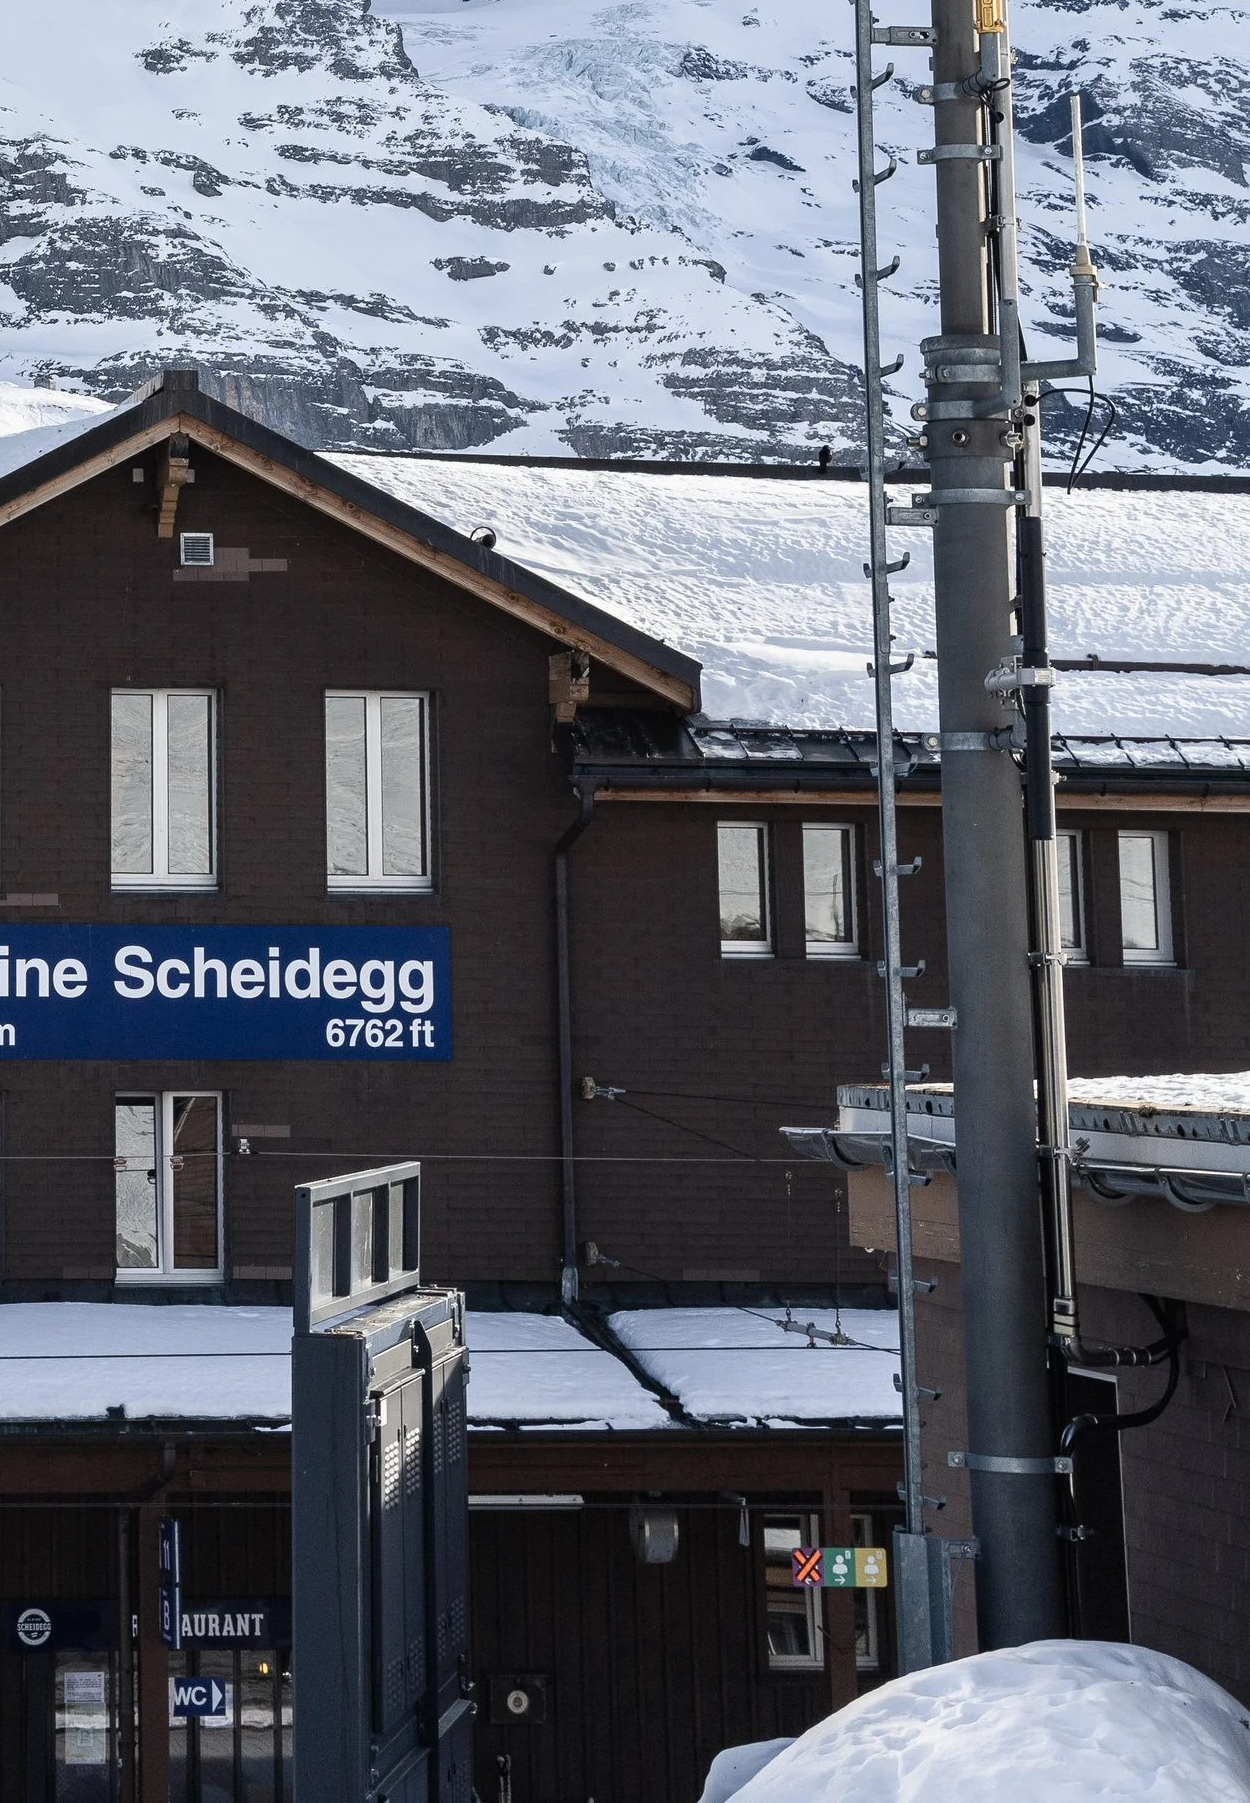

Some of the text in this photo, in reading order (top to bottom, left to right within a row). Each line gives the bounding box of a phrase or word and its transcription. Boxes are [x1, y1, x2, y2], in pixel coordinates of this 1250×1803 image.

[113, 945, 434, 1013] Scheidegg
[325, 1018, 435, 1048] 6762 ft
[16, 1622, 52, 1631] SCHEIDEGG
[173, 1685, 207, 1706] WC
